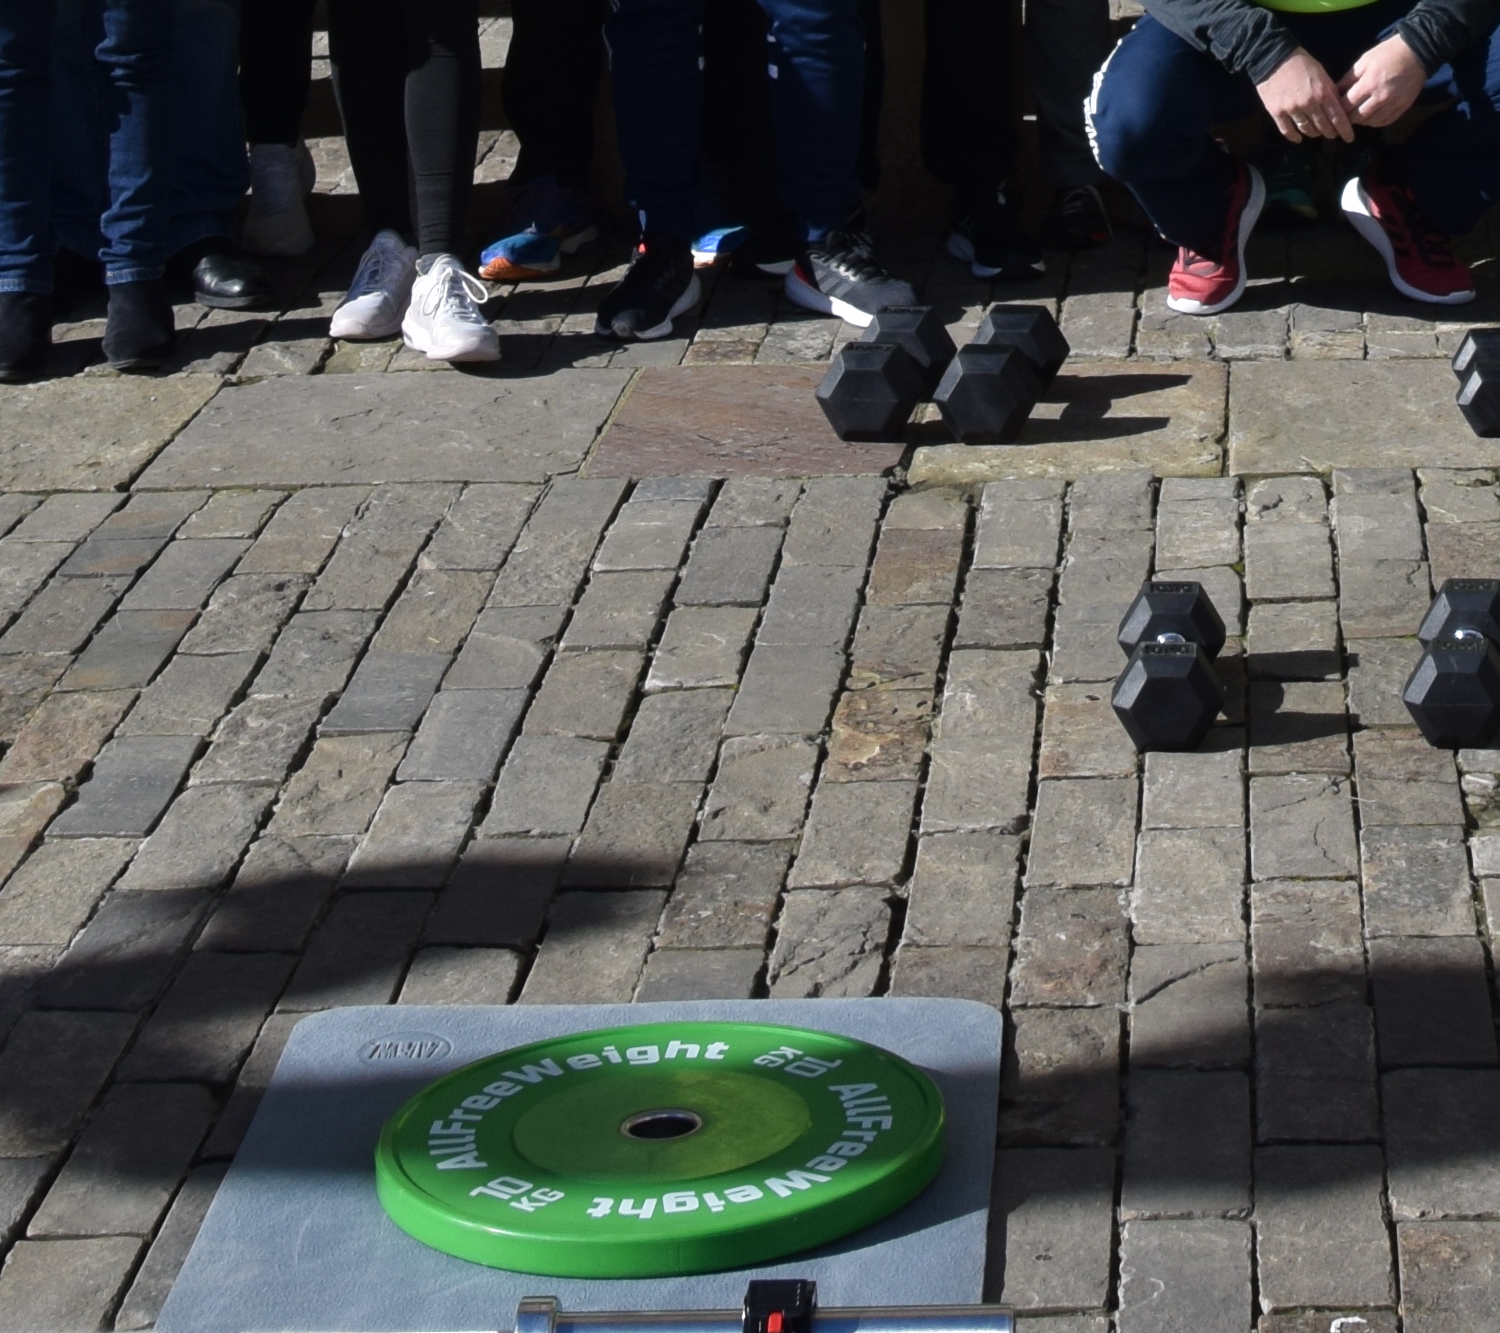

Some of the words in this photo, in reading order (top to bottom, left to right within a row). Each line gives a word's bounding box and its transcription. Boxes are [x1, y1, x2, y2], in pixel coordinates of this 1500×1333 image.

[752, 1045, 805, 1069] KG
[783, 1055, 844, 1079] 10
[428, 1038, 731, 1172] AllFreeWeight
[586, 1081, 894, 1221] AllFreeWeight
[469, 1174, 535, 1203] 10
[511, 1185, 566, 1214] KG
